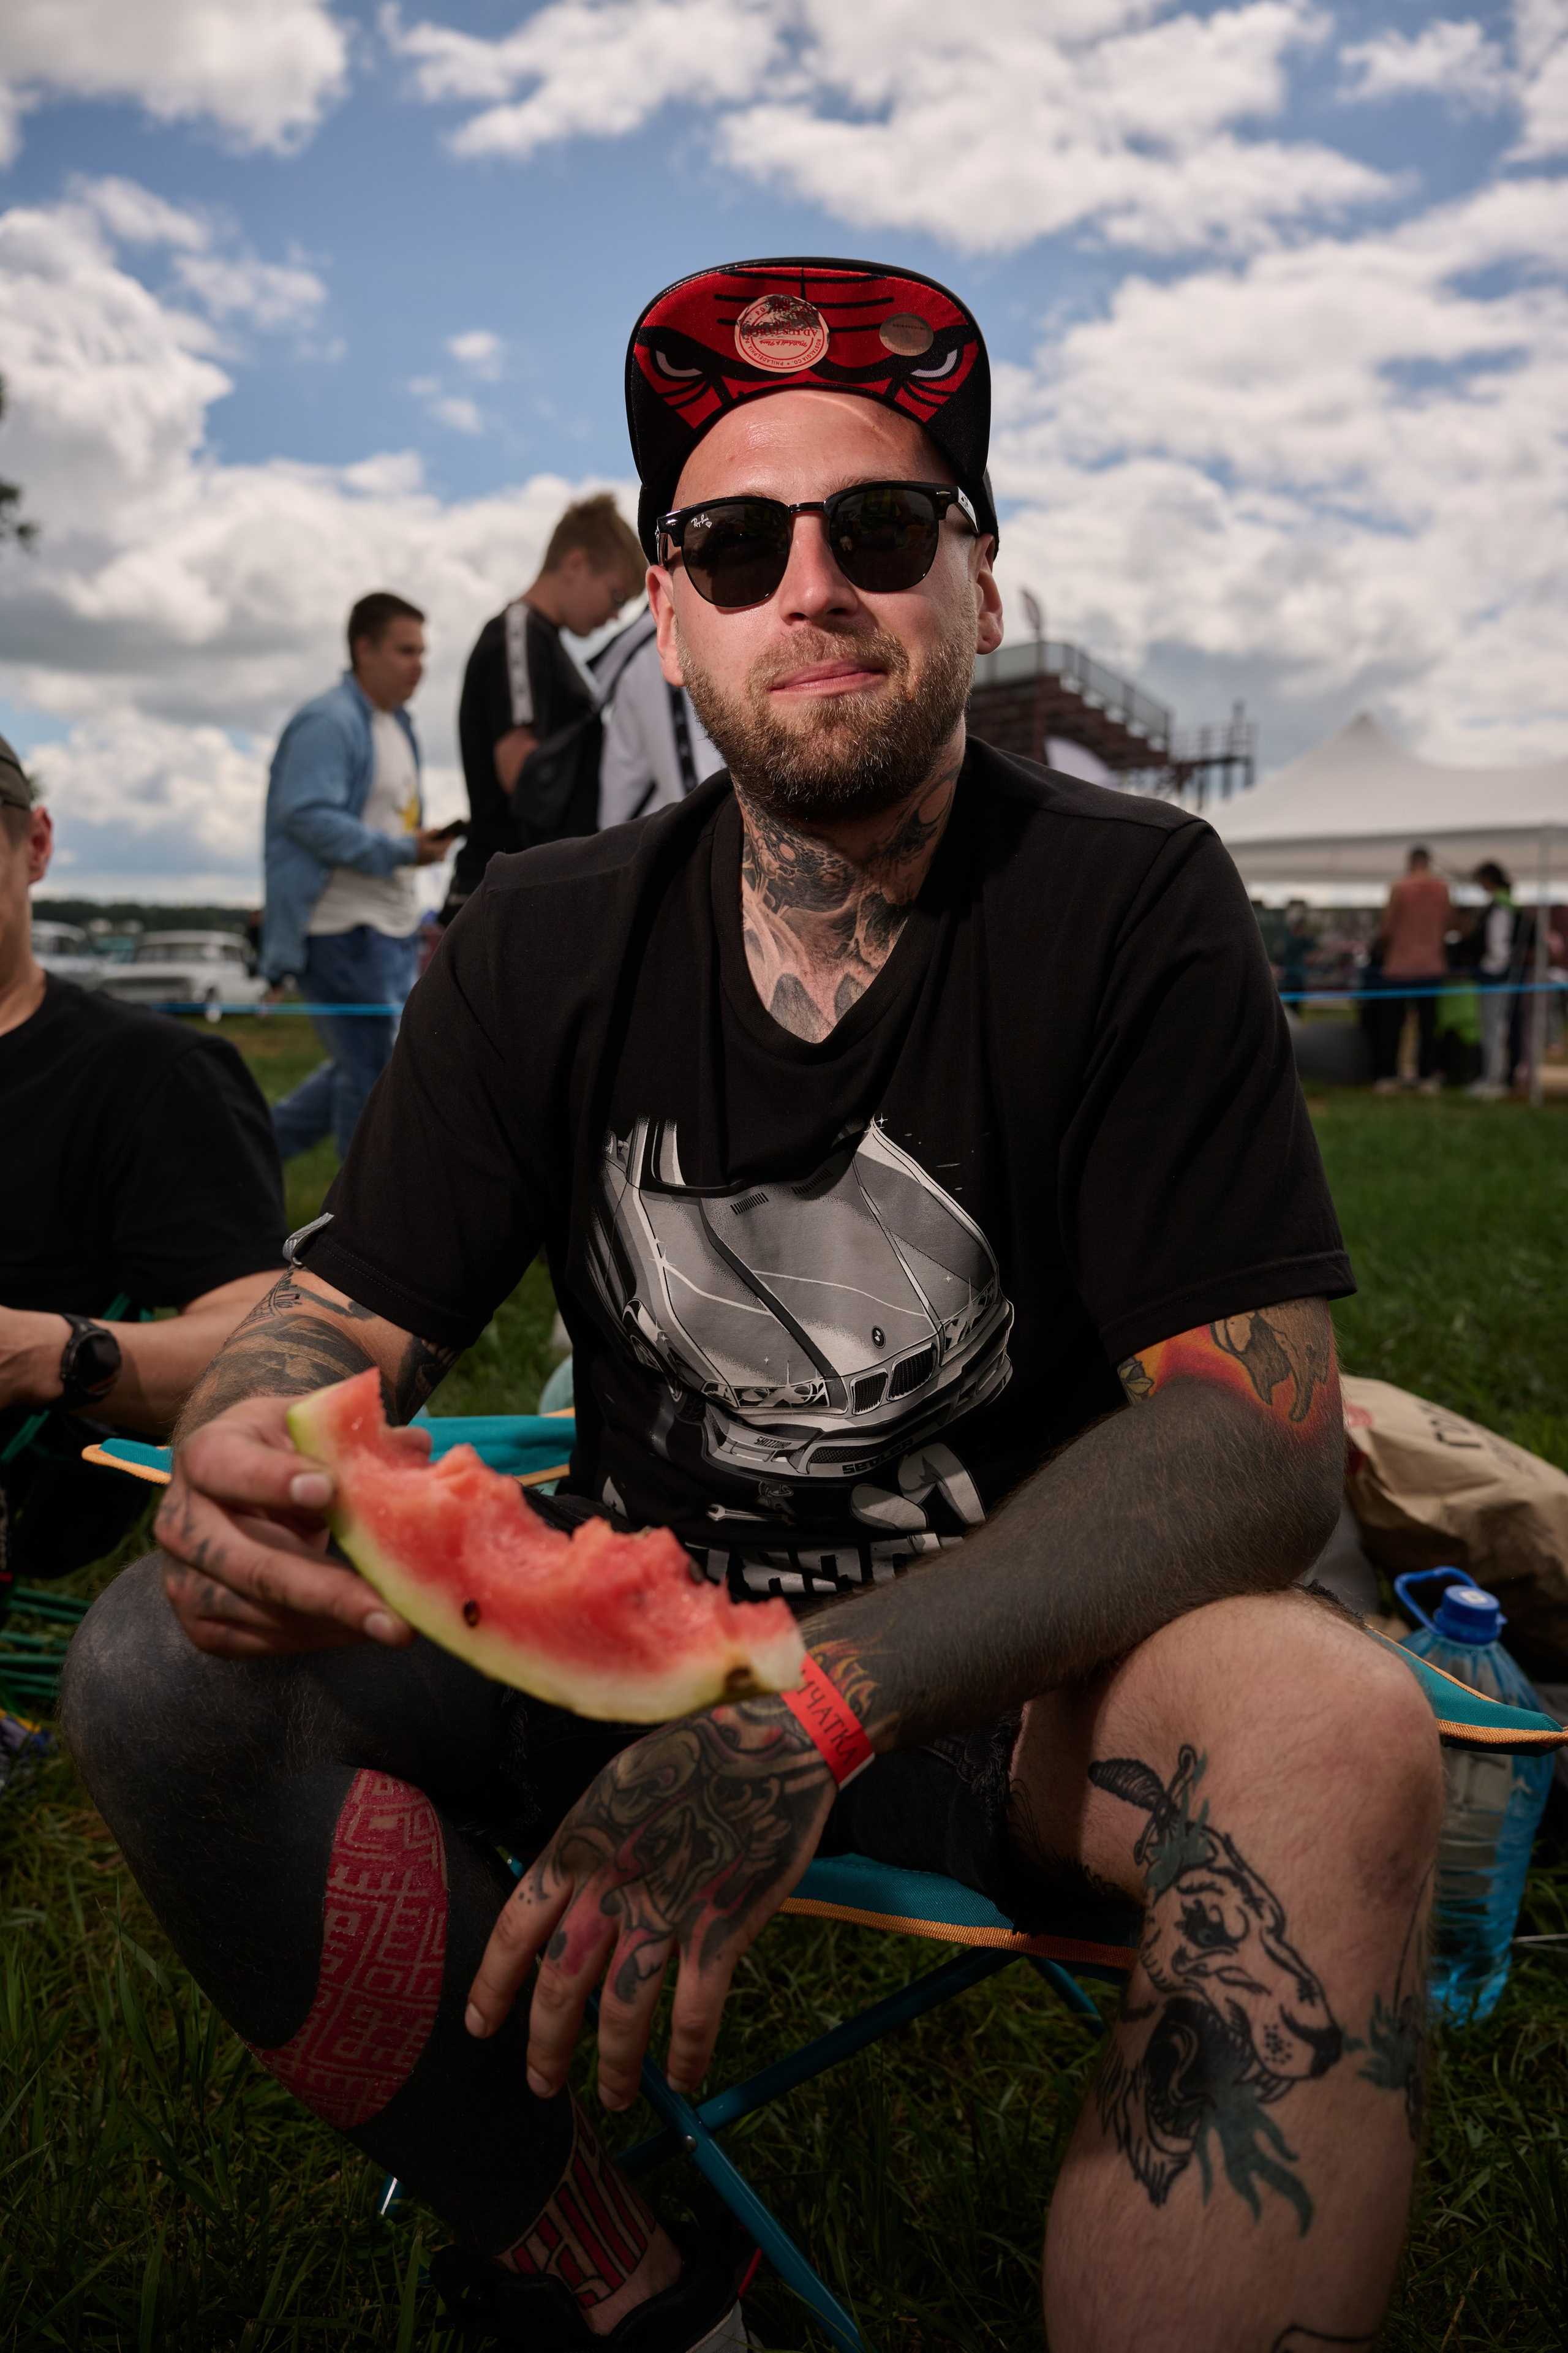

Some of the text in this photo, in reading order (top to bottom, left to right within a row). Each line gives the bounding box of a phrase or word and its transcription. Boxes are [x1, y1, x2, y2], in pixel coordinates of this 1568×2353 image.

[747, 328, 818, 337] ADJUSTABLE
[748, 344, 784, 366] PHILADELPHIA,
[802, 339, 821, 361] NOSTALGIA
